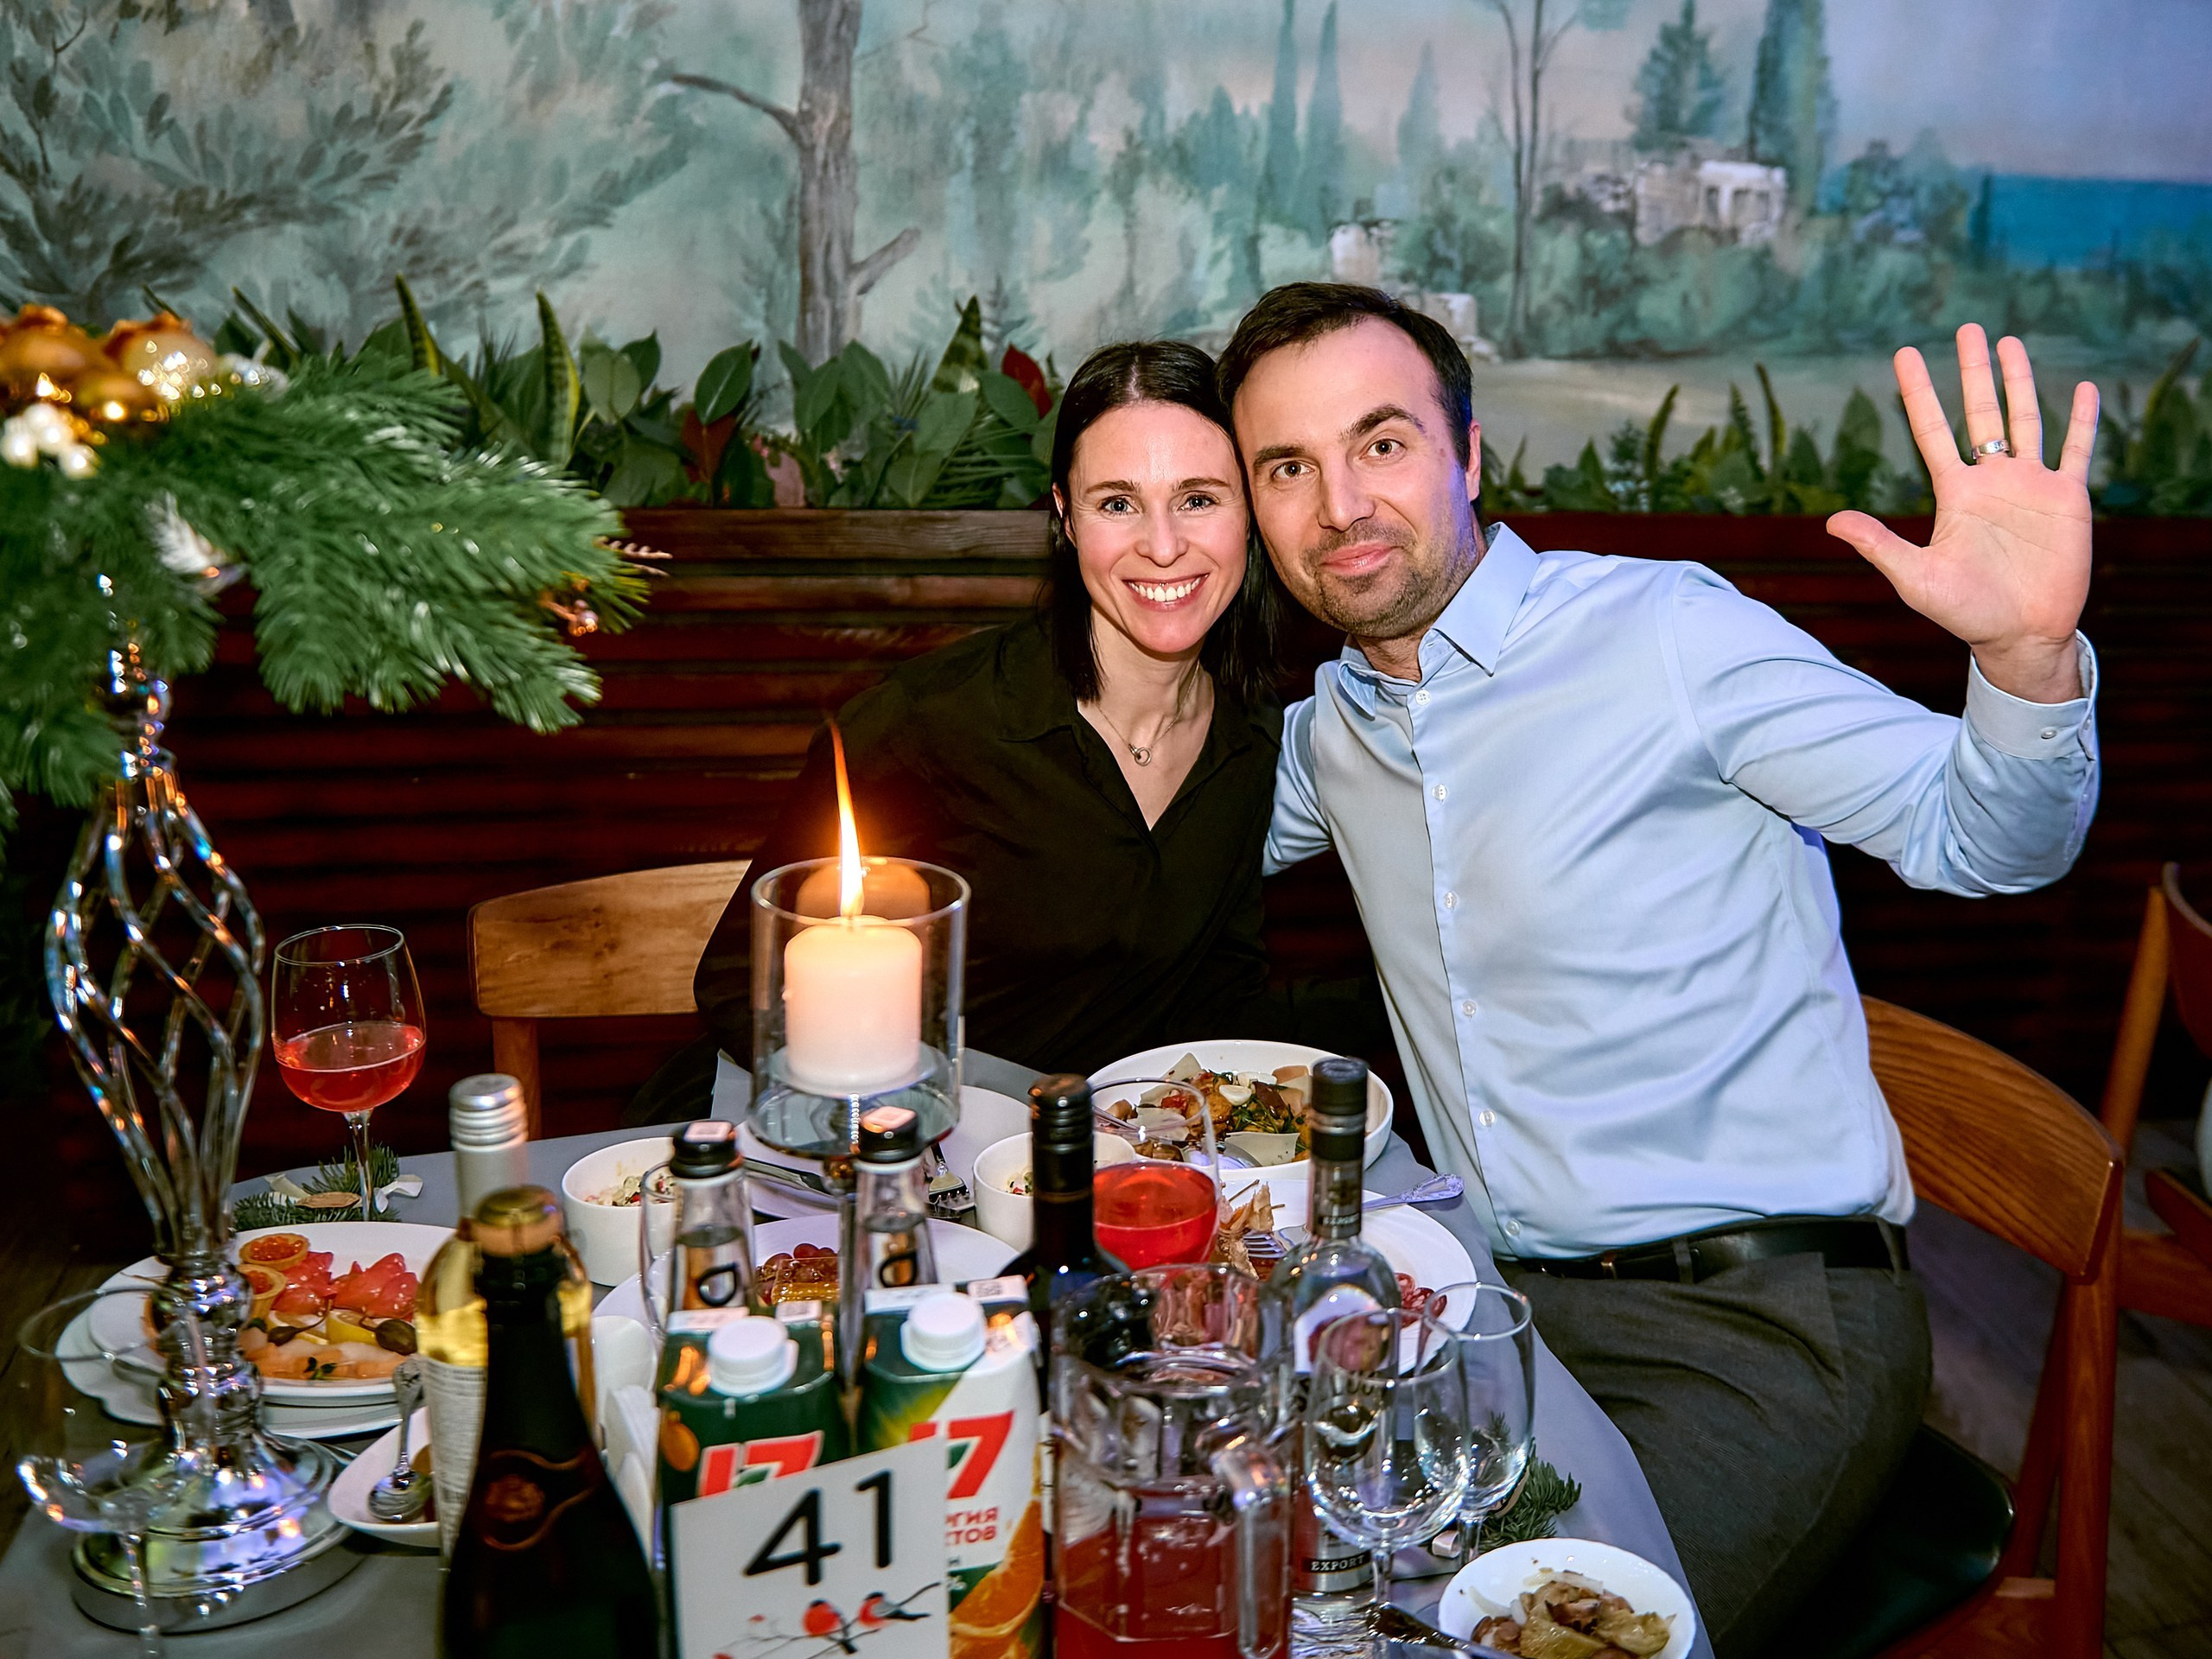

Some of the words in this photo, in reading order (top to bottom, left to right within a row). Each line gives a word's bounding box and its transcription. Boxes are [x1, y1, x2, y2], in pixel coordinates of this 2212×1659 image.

[743, 1469, 893, 1586] 41
[945, 1525, 996, 1546] ТОВ
[1311, 1554, 1365, 1571] EXPORT
